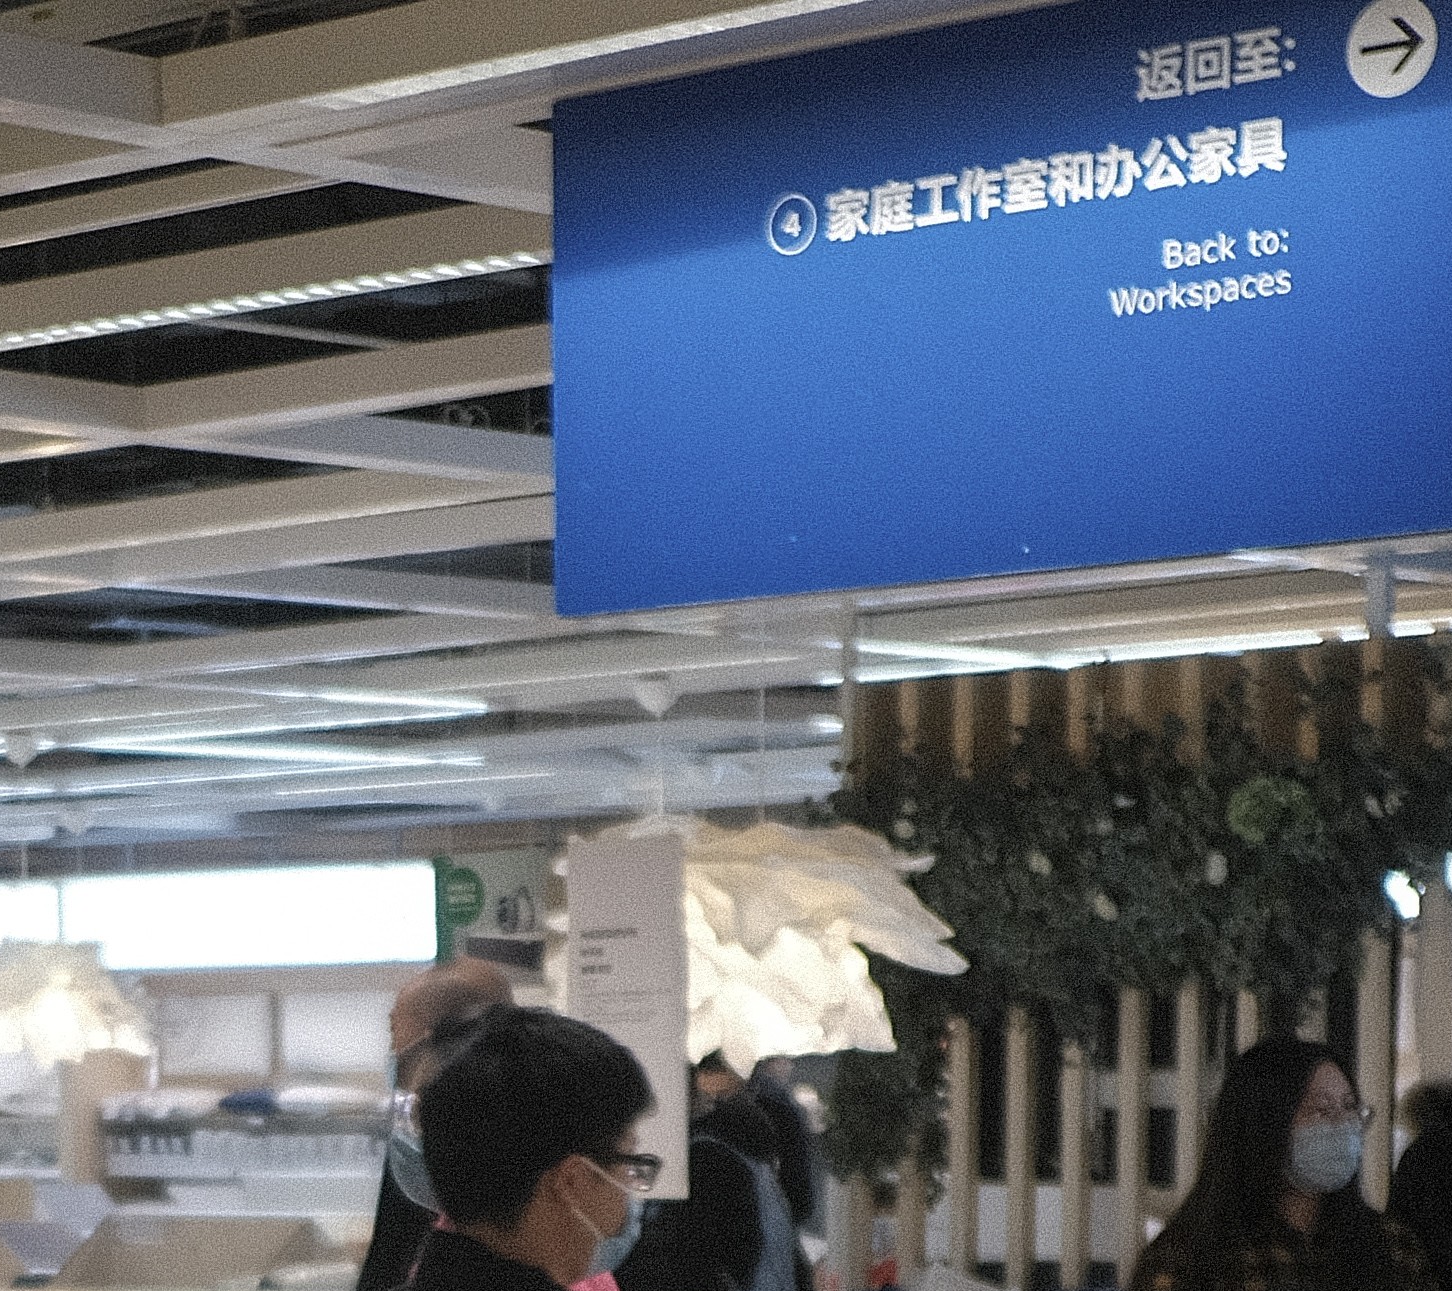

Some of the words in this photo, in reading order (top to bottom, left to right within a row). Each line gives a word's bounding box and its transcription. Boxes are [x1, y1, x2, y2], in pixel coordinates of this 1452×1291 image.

[824, 117, 1288, 243] 家庭工作室和办公家具
[1162, 232, 1236, 271] Back
[1248, 226, 1290, 259] to:
[1110, 267, 1293, 318] Workspaces
